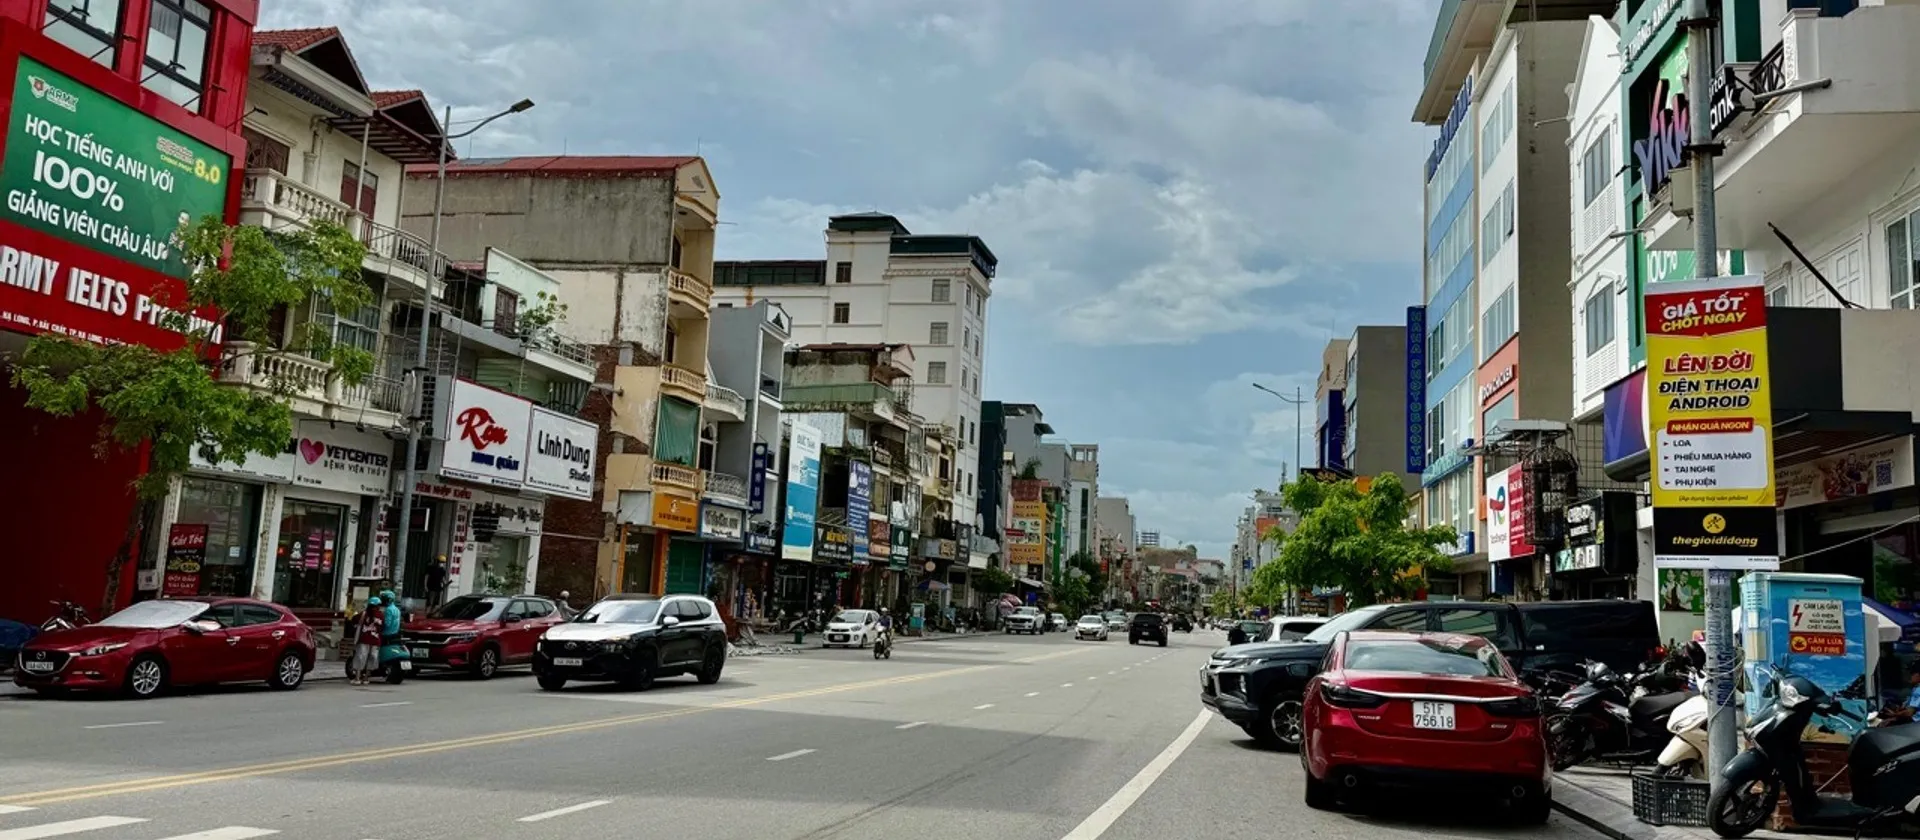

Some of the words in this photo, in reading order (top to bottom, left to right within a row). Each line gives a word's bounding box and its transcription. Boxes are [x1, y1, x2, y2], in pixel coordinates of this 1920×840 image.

[1710, 84, 1735, 131] ank
[1634, 79, 1690, 196] Vikk
[25, 113, 63, 145] HỌC
[64, 131, 114, 168] TIẾNG
[114, 153, 148, 182] ANH
[150, 167, 175, 193] VỚI
[33, 150, 124, 212] 100%
[7, 189, 60, 226] GIẢNG
[63, 206, 99, 239] VIÊN
[101, 223, 140, 253] CHÂU
[0, 245, 60, 295] RMY
[66, 266, 130, 317] IELTS
[1662, 297, 1698, 320] GIÁ
[1701, 290, 1744, 314] TỐT
[1660, 314, 1701, 332] CHỐT
[1703, 311, 1747, 326] NGAY
[1663, 353, 1709, 376] LÊN
[1711, 349, 1754, 373] ĐỜI
[1659, 377, 1700, 396] ĐIỆN
[1704, 376, 1760, 395] THOẠI
[1668, 395, 1751, 411] ANDROID
[1671, 422, 1699, 433] NHẬN
[1700, 420, 1720, 431] QUÀ
[1720, 420, 1750, 430] NGON
[537, 429, 561, 460] Linh
[562, 437, 591, 469] Dung
[1672, 439, 1692, 448] LOA
[326, 444, 389, 468] VETCENTER
[1673, 451, 1700, 462] PHIẾU
[1701, 452, 1723, 461] MUA
[1724, 450, 1752, 461] HÀNG
[324, 459, 345, 471] BỆNH
[348, 462, 364, 475] VIỆN
[568, 467, 591, 483] Studio
[1674, 465, 1689, 474] TAI
[1689, 465, 1716, 474] NGHE
[1675, 478, 1694, 488] PHỤ
[1695, 477, 1717, 488] KIỆN
[1672, 535, 1758, 548] thegioididong
[1810, 645, 1823, 654] NO
[1824, 646, 1841, 654] FIRE
[1423, 702, 1444, 715] 51F
[1416, 714, 1454, 729] 756.18
